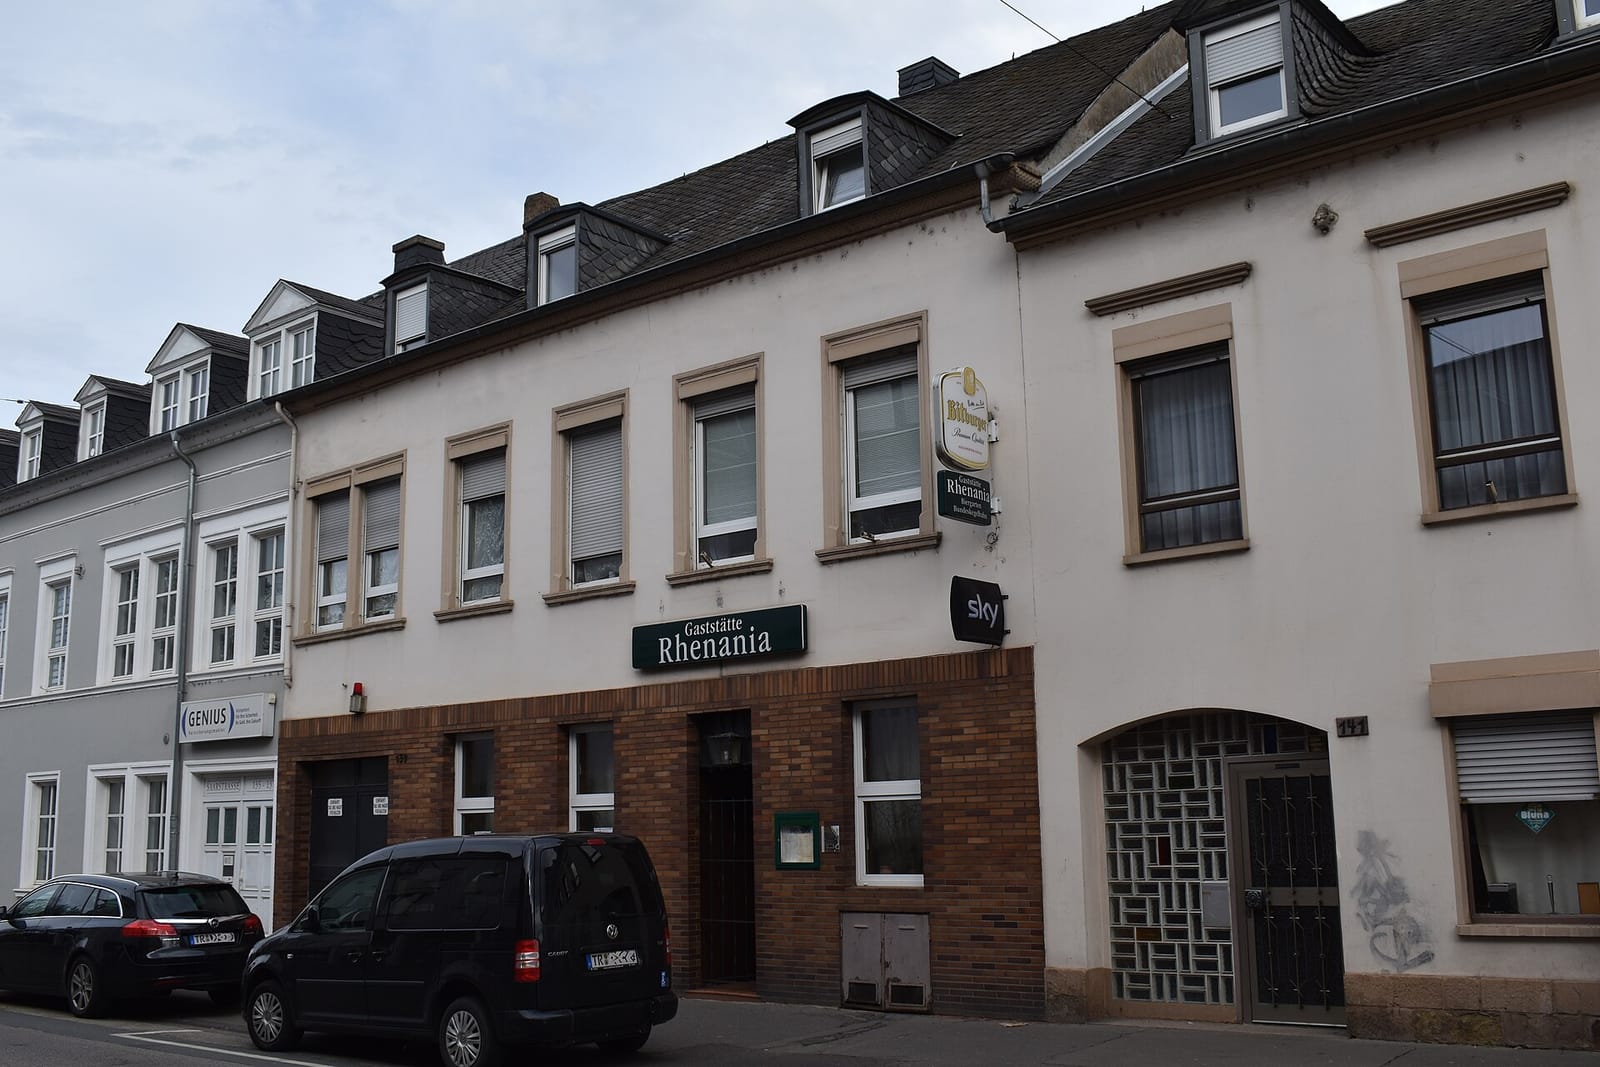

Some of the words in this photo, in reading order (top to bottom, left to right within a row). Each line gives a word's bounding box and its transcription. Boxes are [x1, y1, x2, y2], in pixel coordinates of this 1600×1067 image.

[946, 478, 990, 503] Rhenania
[967, 593, 999, 629] sky
[684, 617, 743, 637] Gaststätte
[658, 625, 773, 664] Rhenania
[188, 707, 227, 727] GENIUS
[1338, 718, 1366, 735] 141
[1520, 810, 1550, 819] Bluna
